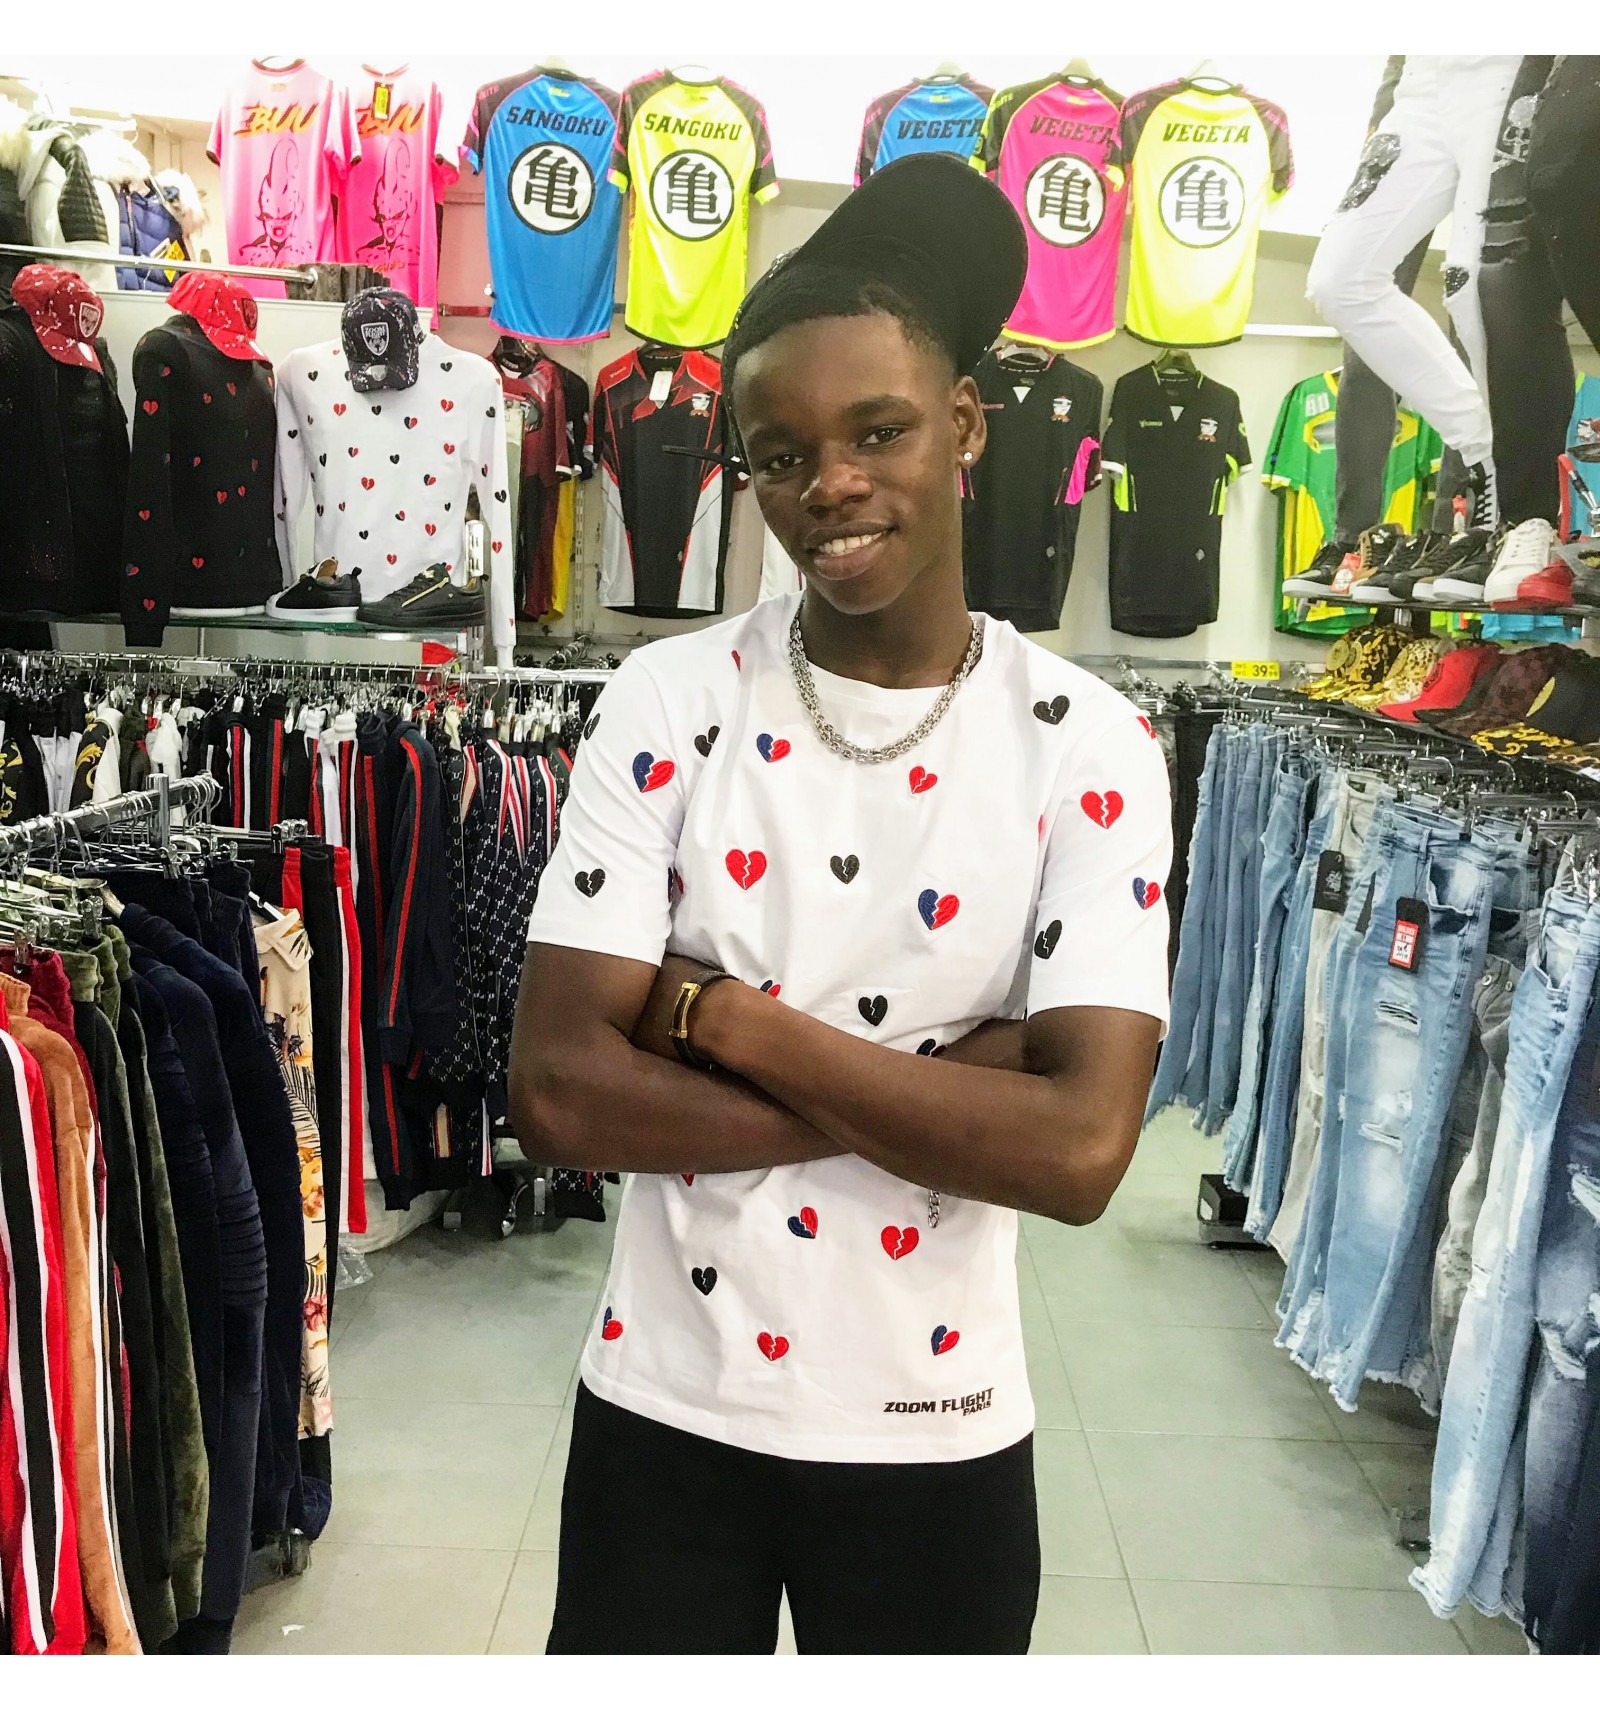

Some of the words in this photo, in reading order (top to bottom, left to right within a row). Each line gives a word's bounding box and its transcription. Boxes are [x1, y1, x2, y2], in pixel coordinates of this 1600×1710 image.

[506, 105, 609, 137] SANGOKU
[644, 112, 742, 141] SANGOKU
[897, 118, 984, 139] VEGETA
[1030, 115, 1114, 144] VEGETA
[1163, 123, 1250, 143] VEGETA
[524, 148, 580, 220] 亀
[664, 156, 722, 225] 亀
[1039, 160, 1092, 232] 亀
[1174, 164, 1232, 231] 亀
[1252, 664, 1268, 677] 39
[883, 1401, 937, 1413] ZOOM
[941, 1387, 995, 1413] FLIGHT
[962, 1400, 992, 1416] PARIS
